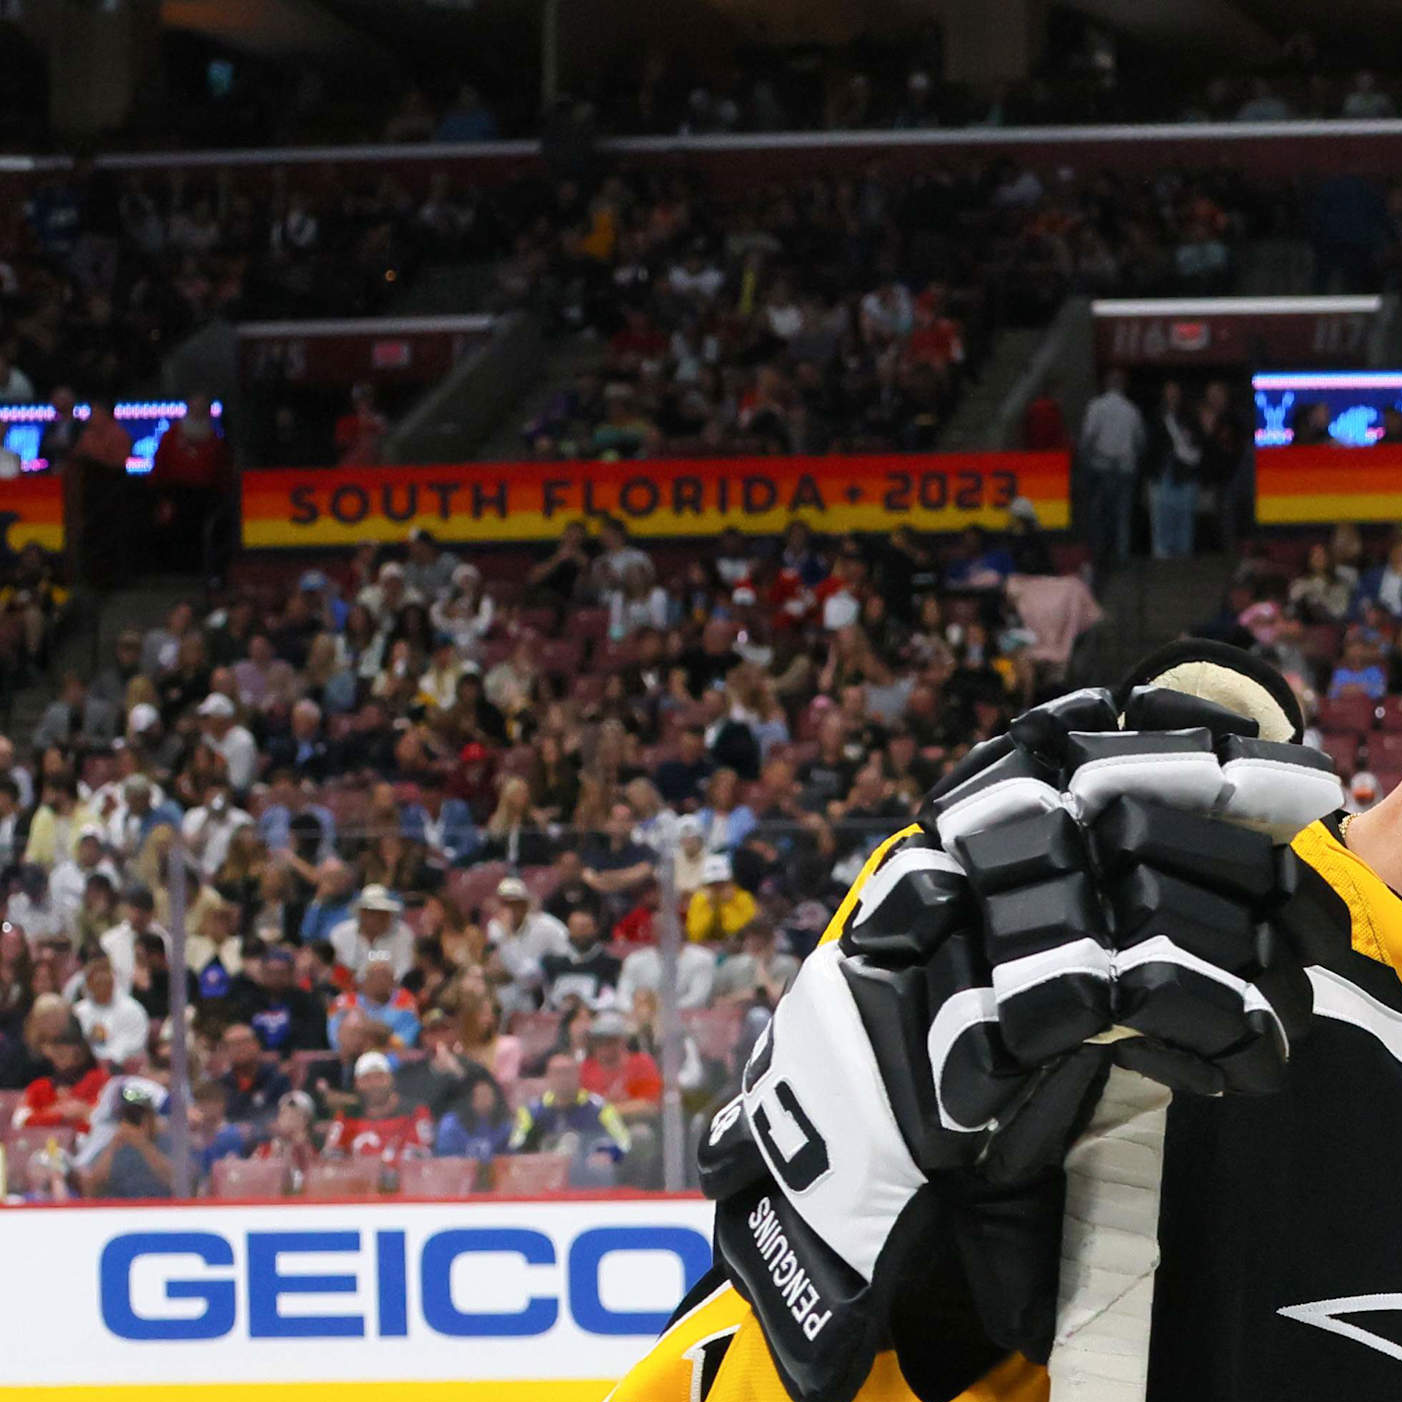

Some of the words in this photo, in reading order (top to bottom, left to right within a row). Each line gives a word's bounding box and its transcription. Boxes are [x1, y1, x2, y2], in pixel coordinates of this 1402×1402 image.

[288, 479, 508, 525] SOUTH
[541, 473, 828, 519] FLORIDA
[884, 469, 1020, 512] 2023
[99, 1225, 712, 1342] GEICO
[748, 1196, 833, 1342] PENGUINS
